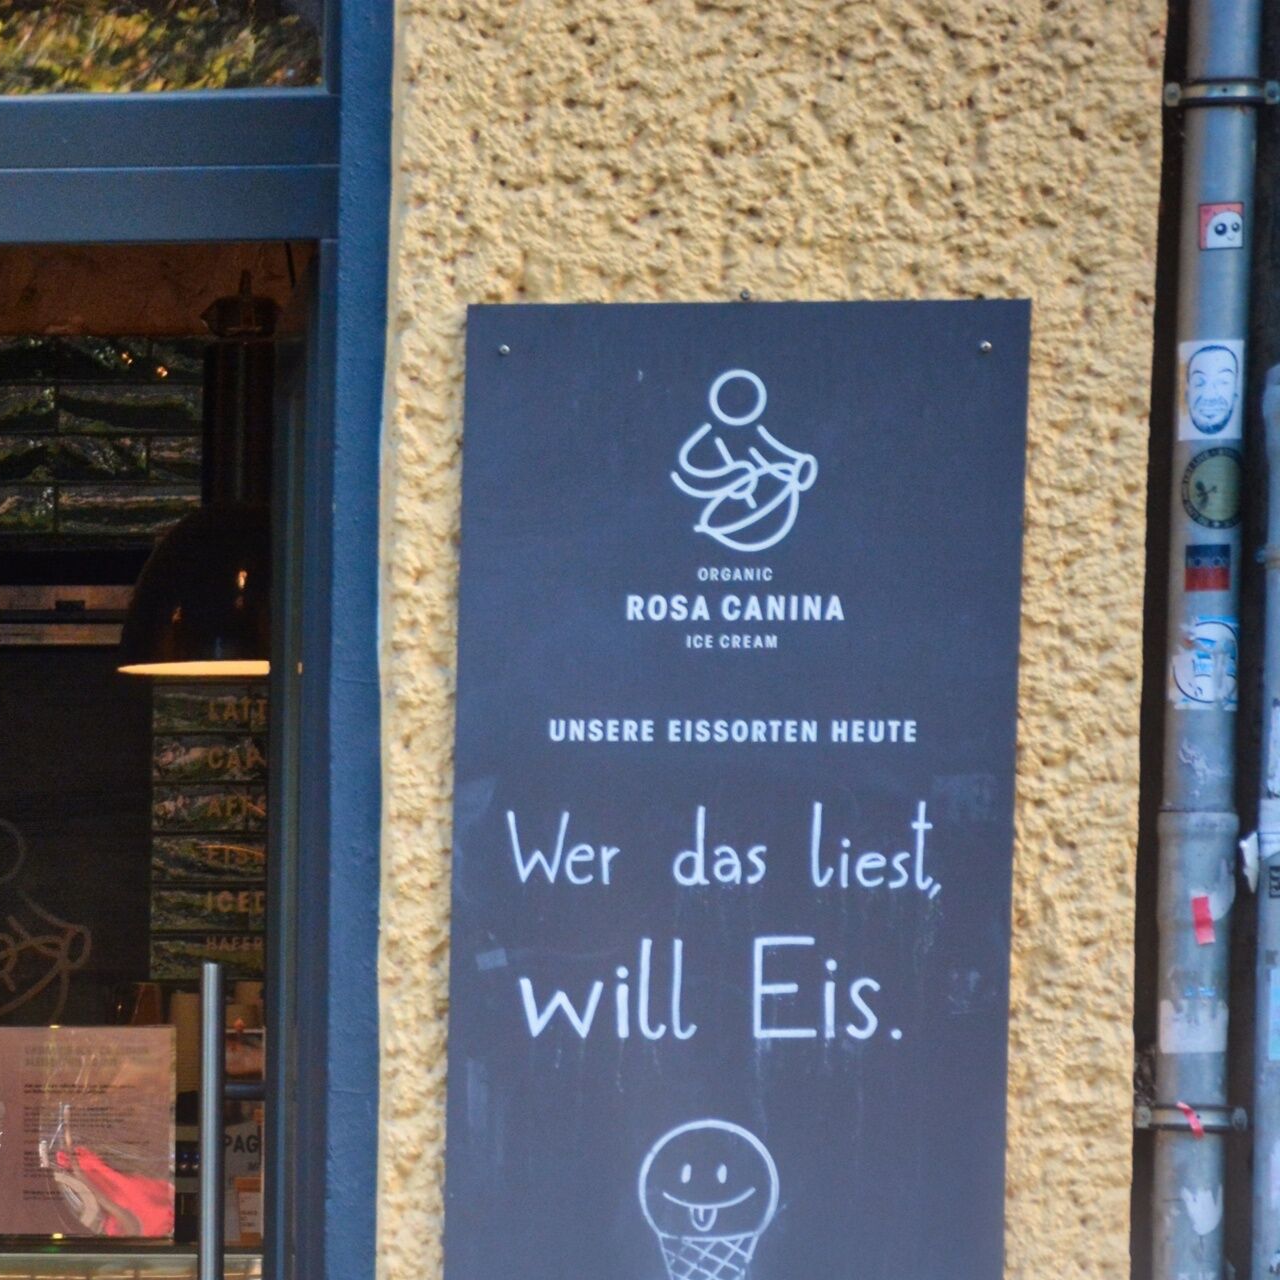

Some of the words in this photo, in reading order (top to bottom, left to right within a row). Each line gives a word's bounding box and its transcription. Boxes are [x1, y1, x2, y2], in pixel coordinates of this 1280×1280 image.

[697, 568, 773, 581] ORGANIC
[626, 595, 710, 621] ROSA
[721, 595, 845, 621] CANINA
[686, 635, 714, 648] ICE
[719, 635, 778, 649] CREAM
[549, 719, 654, 742] UNSERE
[668, 719, 817, 742] EISSORTEN
[831, 720, 917, 742] HEUTE
[506, 810, 620, 885] Wer
[672, 806, 767, 886] das
[810, 801, 941, 899] liest,
[519, 938, 697, 1040] will
[752, 935, 901, 1042] Eis.
